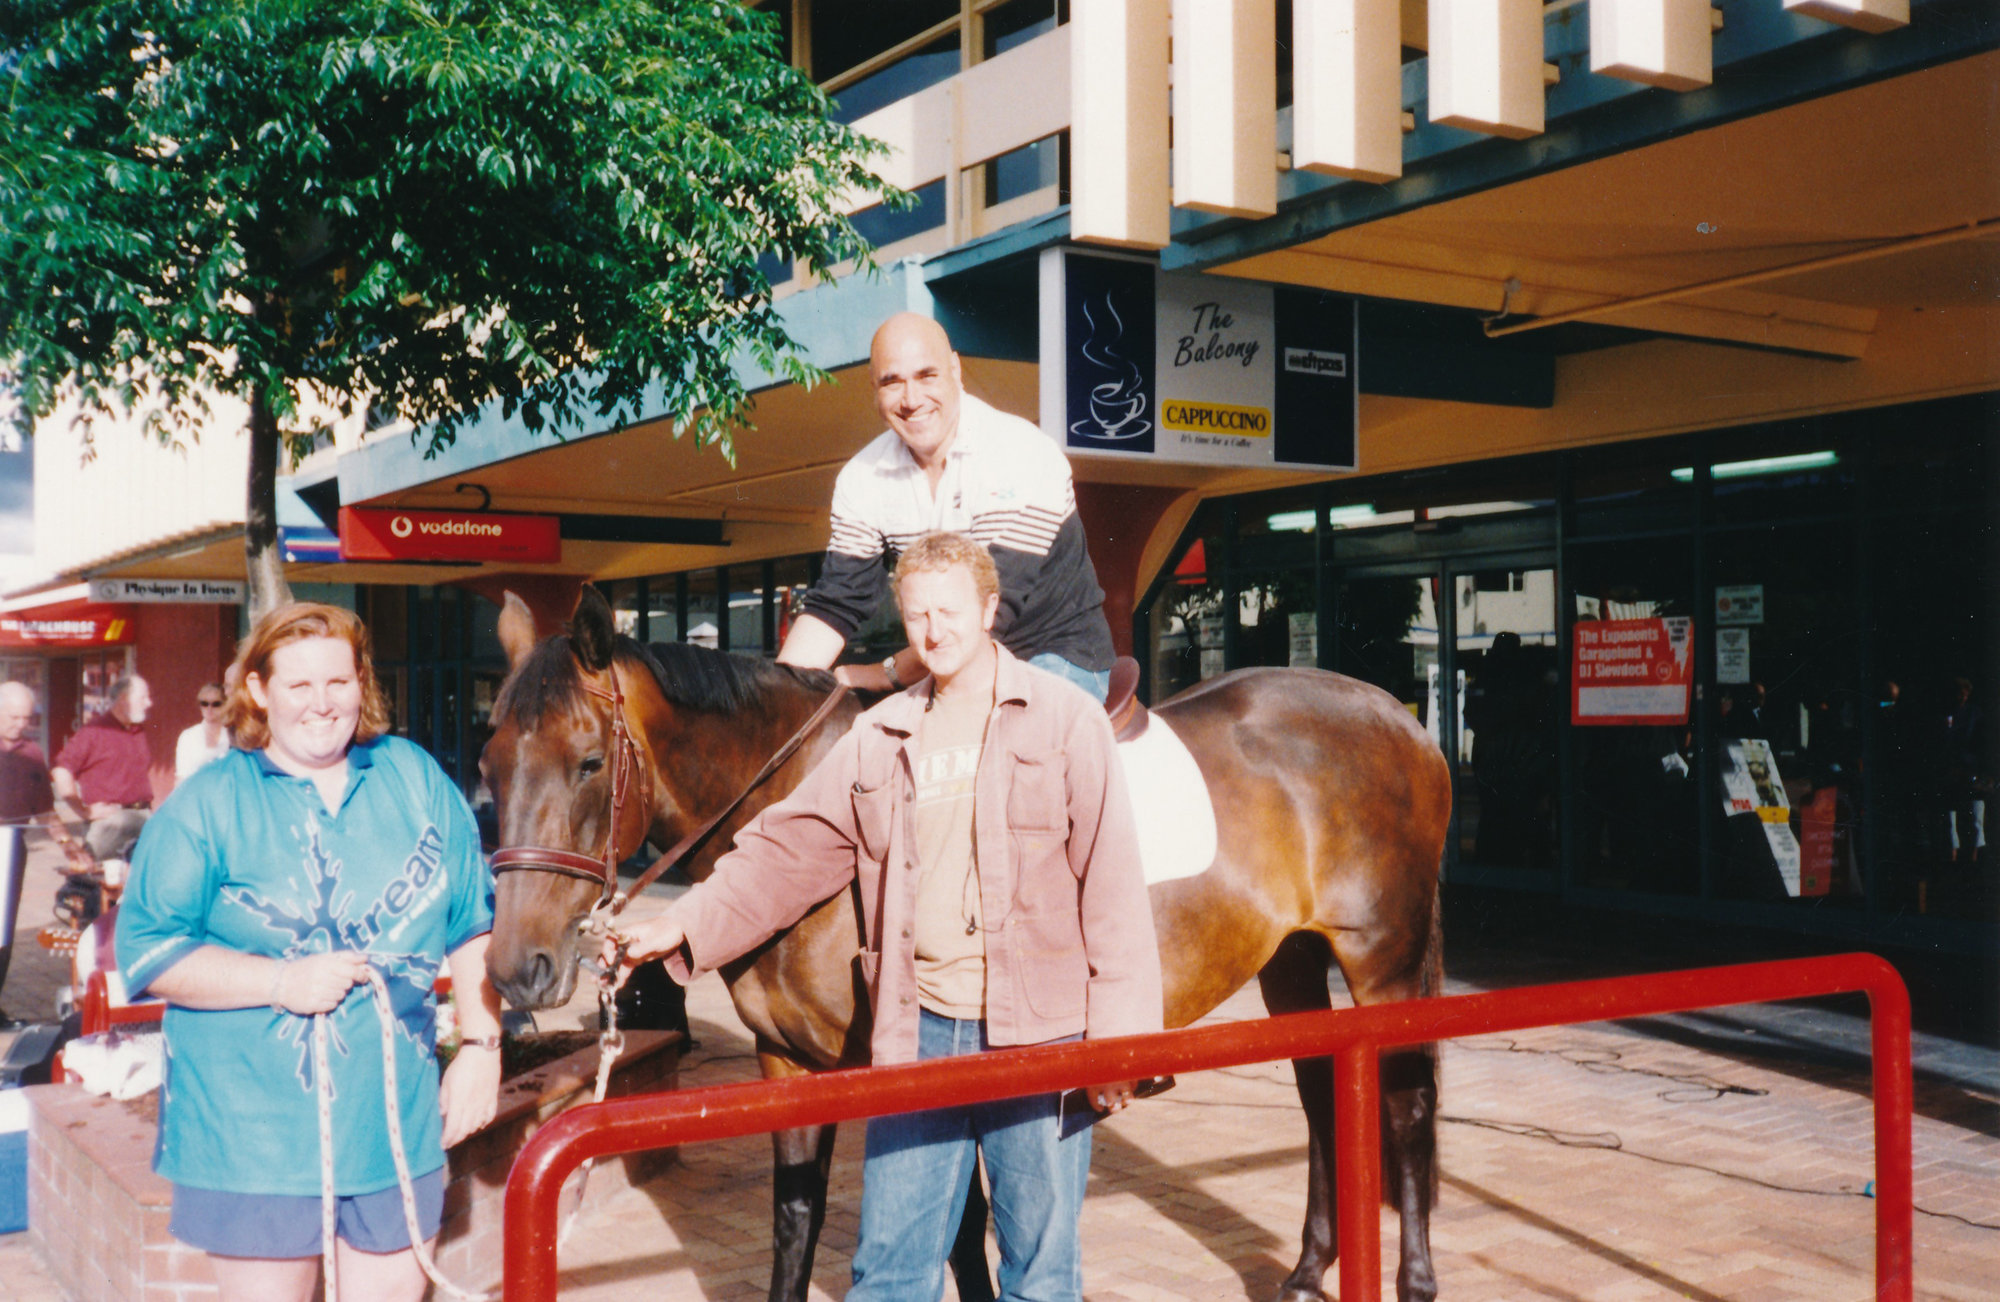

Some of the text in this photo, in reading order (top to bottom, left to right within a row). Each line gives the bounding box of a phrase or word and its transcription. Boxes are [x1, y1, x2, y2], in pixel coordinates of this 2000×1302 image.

[1192, 301, 1234, 334] The
[1174, 333, 1260, 367] Balcony
[1166, 405, 1267, 432] CAPPUCCINO
[419, 520, 502, 536] vodafone
[183, 583, 197, 595] In
[201, 583, 236, 596] Focus
[1579, 630, 1599, 644] The
[1601, 627, 1659, 644] Exponents
[1578, 645, 1643, 661] Garageland
